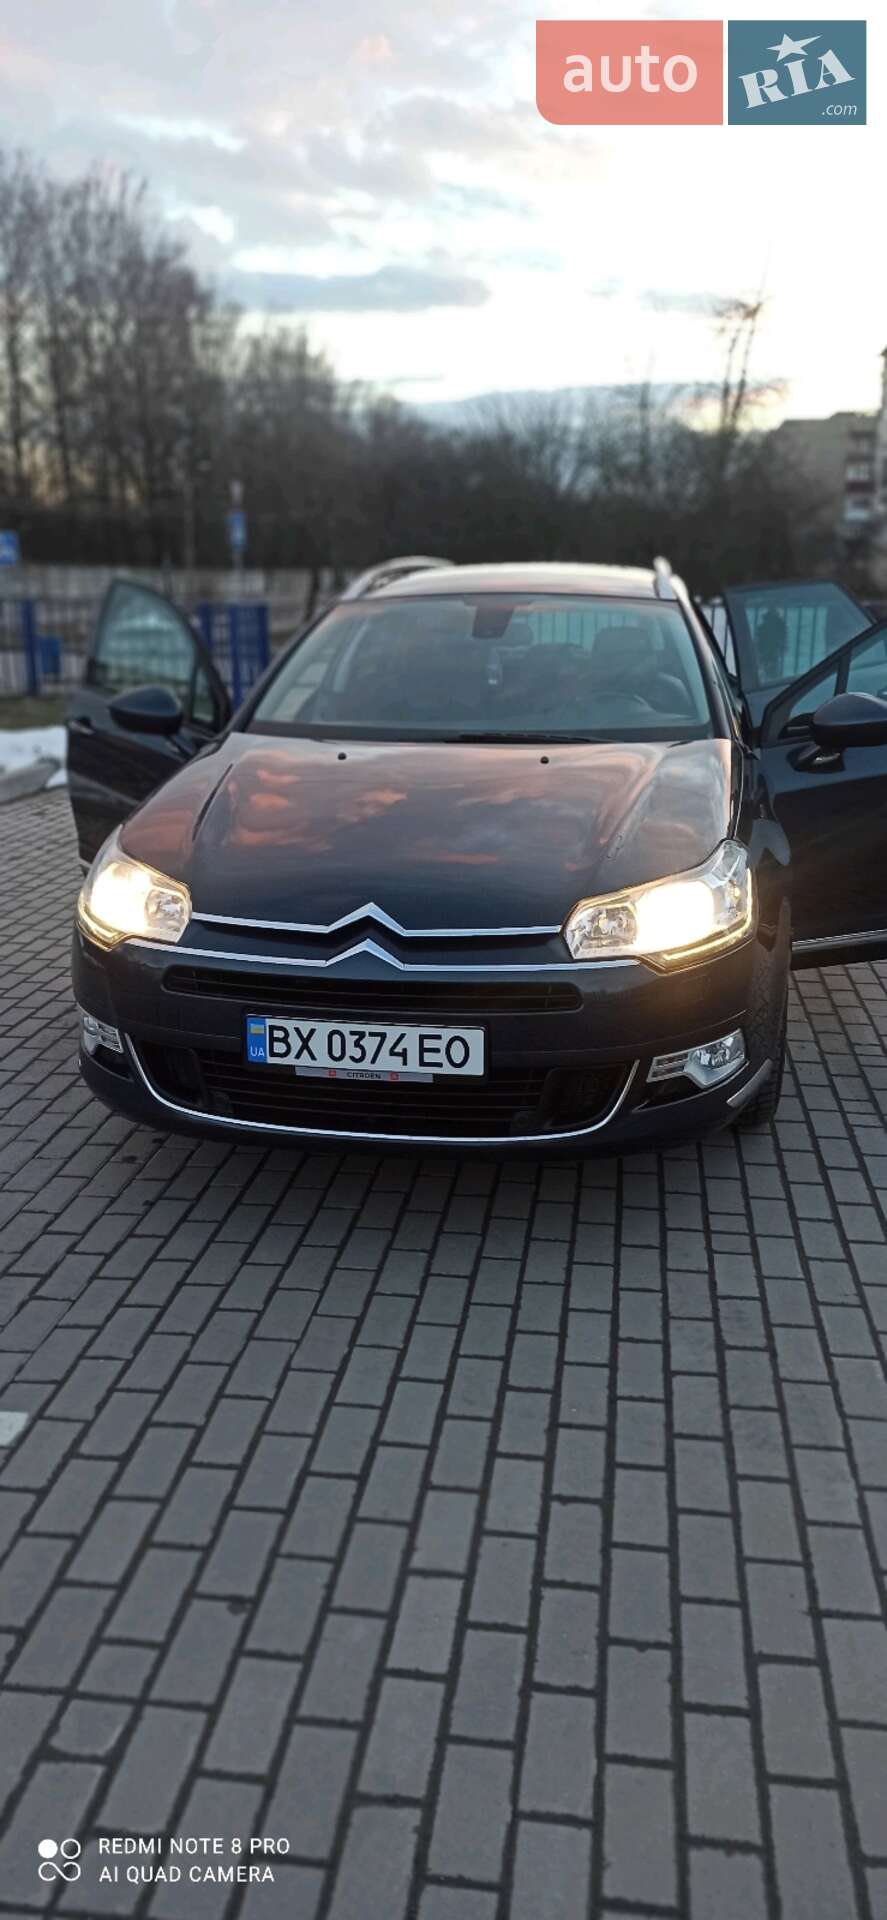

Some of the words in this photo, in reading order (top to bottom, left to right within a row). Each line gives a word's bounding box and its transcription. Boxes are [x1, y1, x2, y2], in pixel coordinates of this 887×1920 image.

[250, 1046, 265, 1057] UA
[268, 1024, 318, 1061] BX
[327, 1029, 408, 1066] 0374
[418, 1034, 471, 1069] EO
